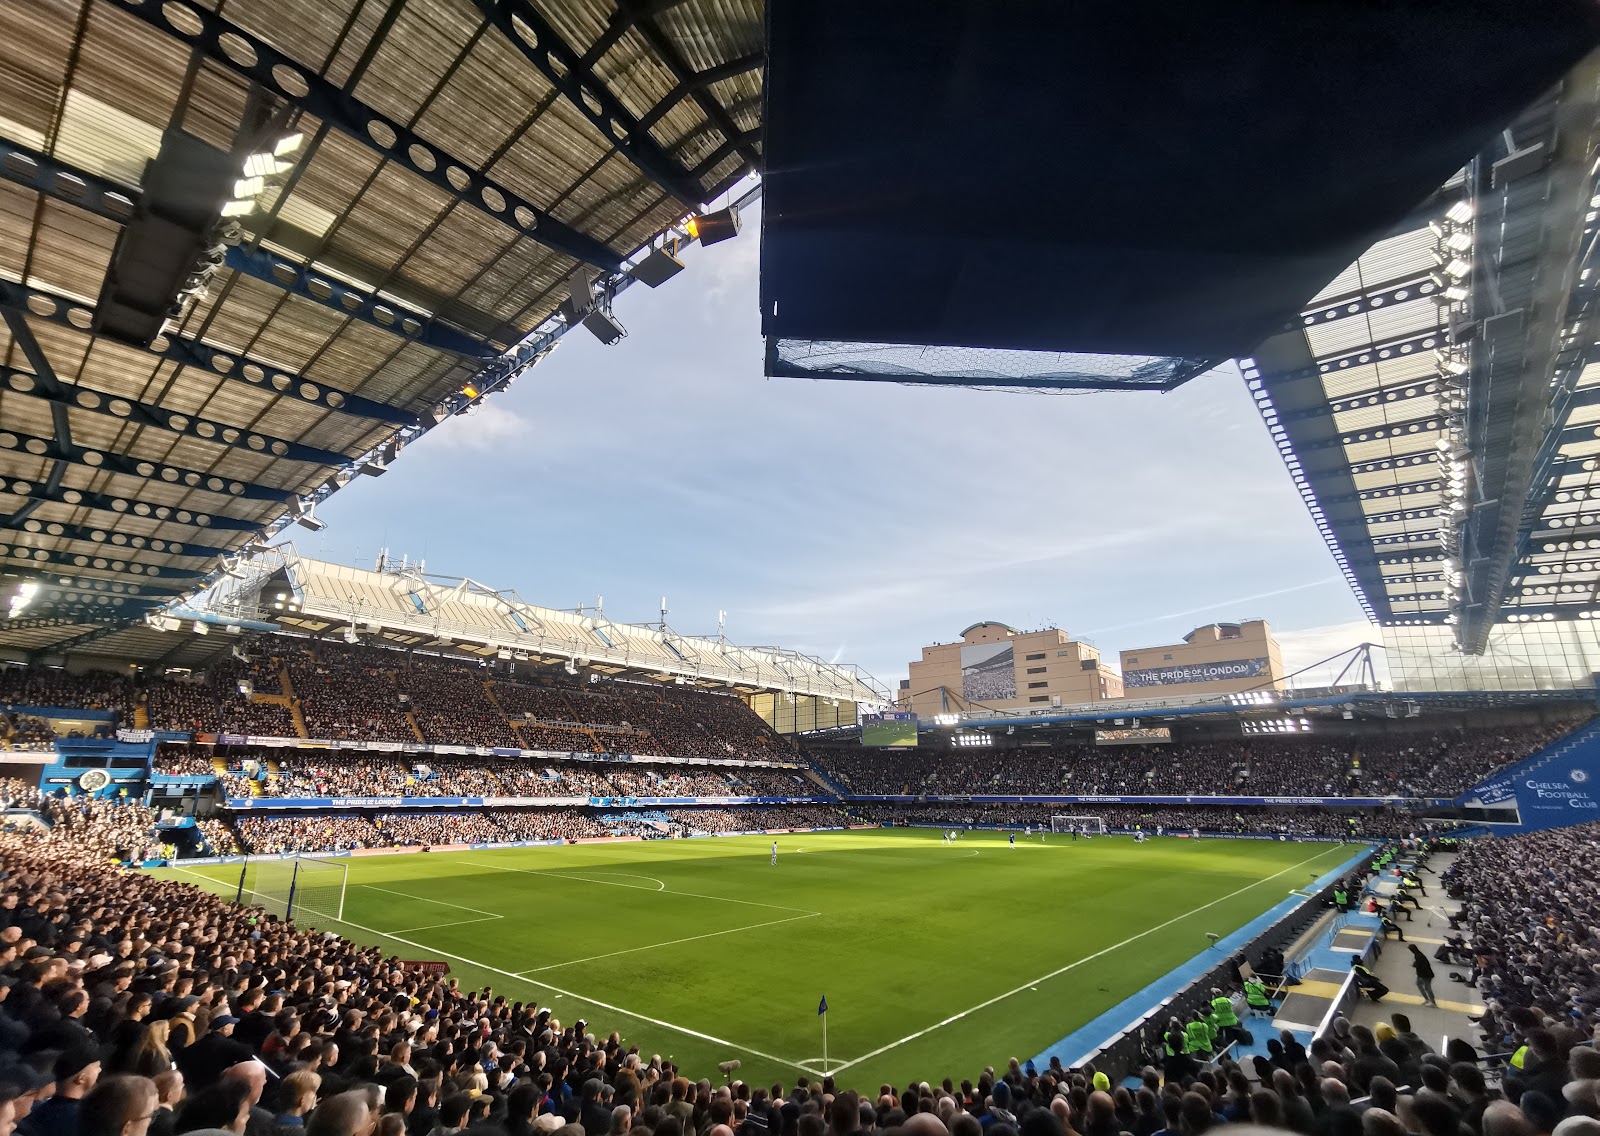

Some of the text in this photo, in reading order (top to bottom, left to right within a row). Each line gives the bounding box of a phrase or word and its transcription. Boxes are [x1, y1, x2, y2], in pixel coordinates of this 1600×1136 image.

[1140, 673, 1159, 681] THE
[1160, 670, 1191, 680] PRIDE
[1203, 665, 1249, 676] LONDON
[1536, 789, 1590, 798] FOOTBALL
[1568, 799, 1599, 808] CLUB
